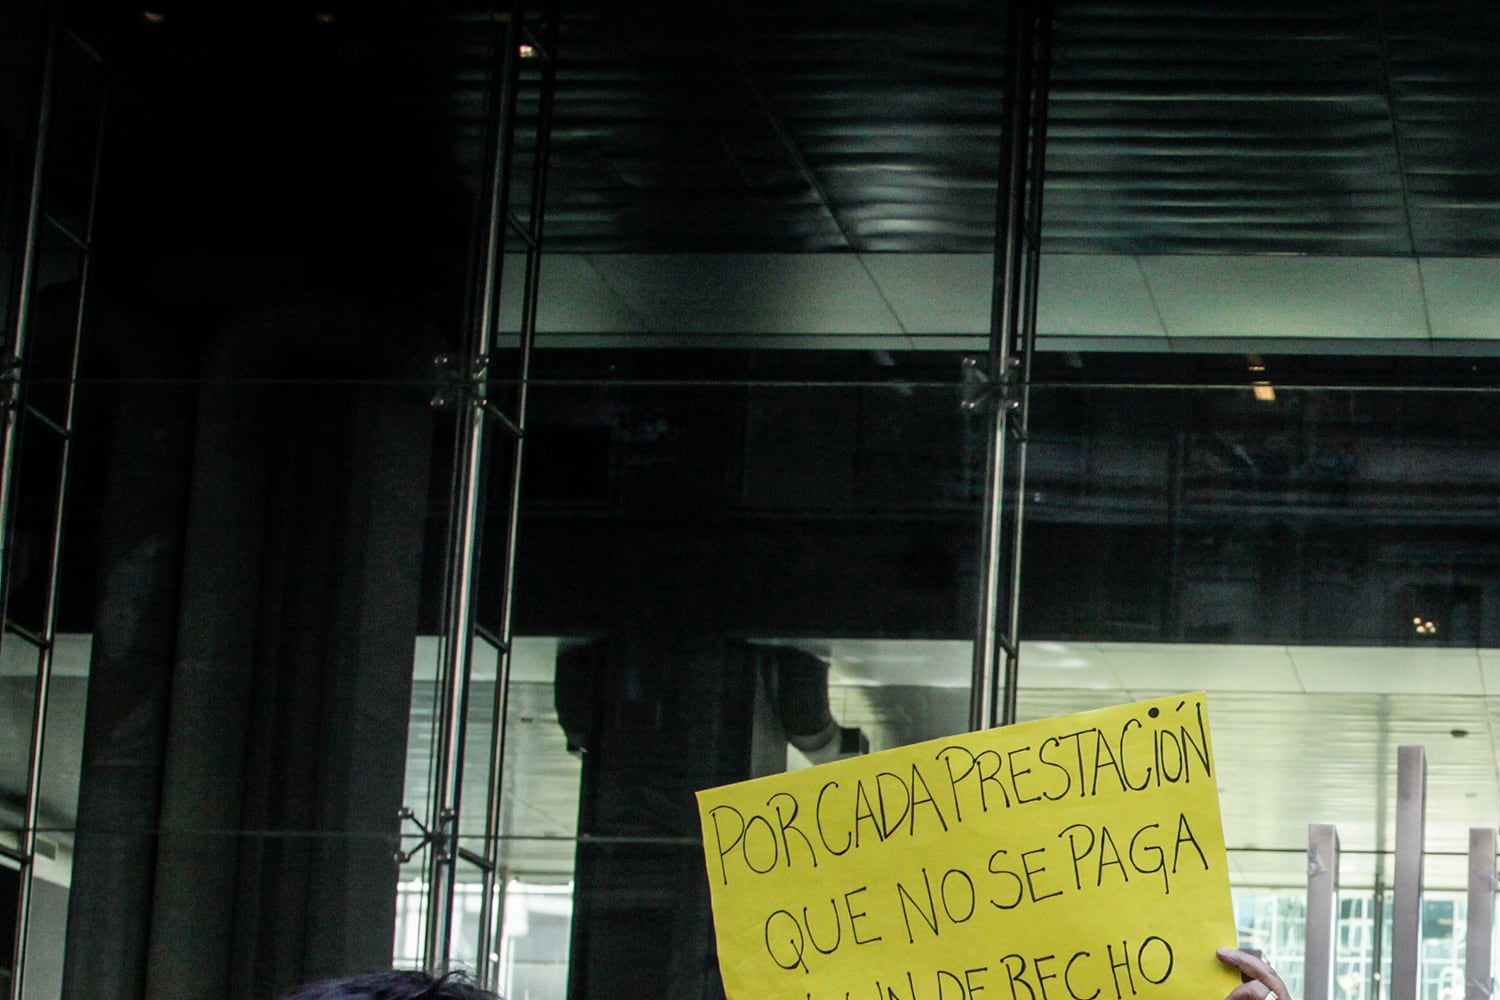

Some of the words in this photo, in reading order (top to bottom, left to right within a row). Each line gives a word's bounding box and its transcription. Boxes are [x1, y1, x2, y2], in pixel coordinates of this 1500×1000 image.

[708, 792, 819, 886] POR
[816, 763, 949, 856] CADA
[764, 886, 882, 974] QUE
[896, 867, 976, 944] NO
[988, 847, 1064, 910] SE
[1058, 812, 1209, 894] PAGA
